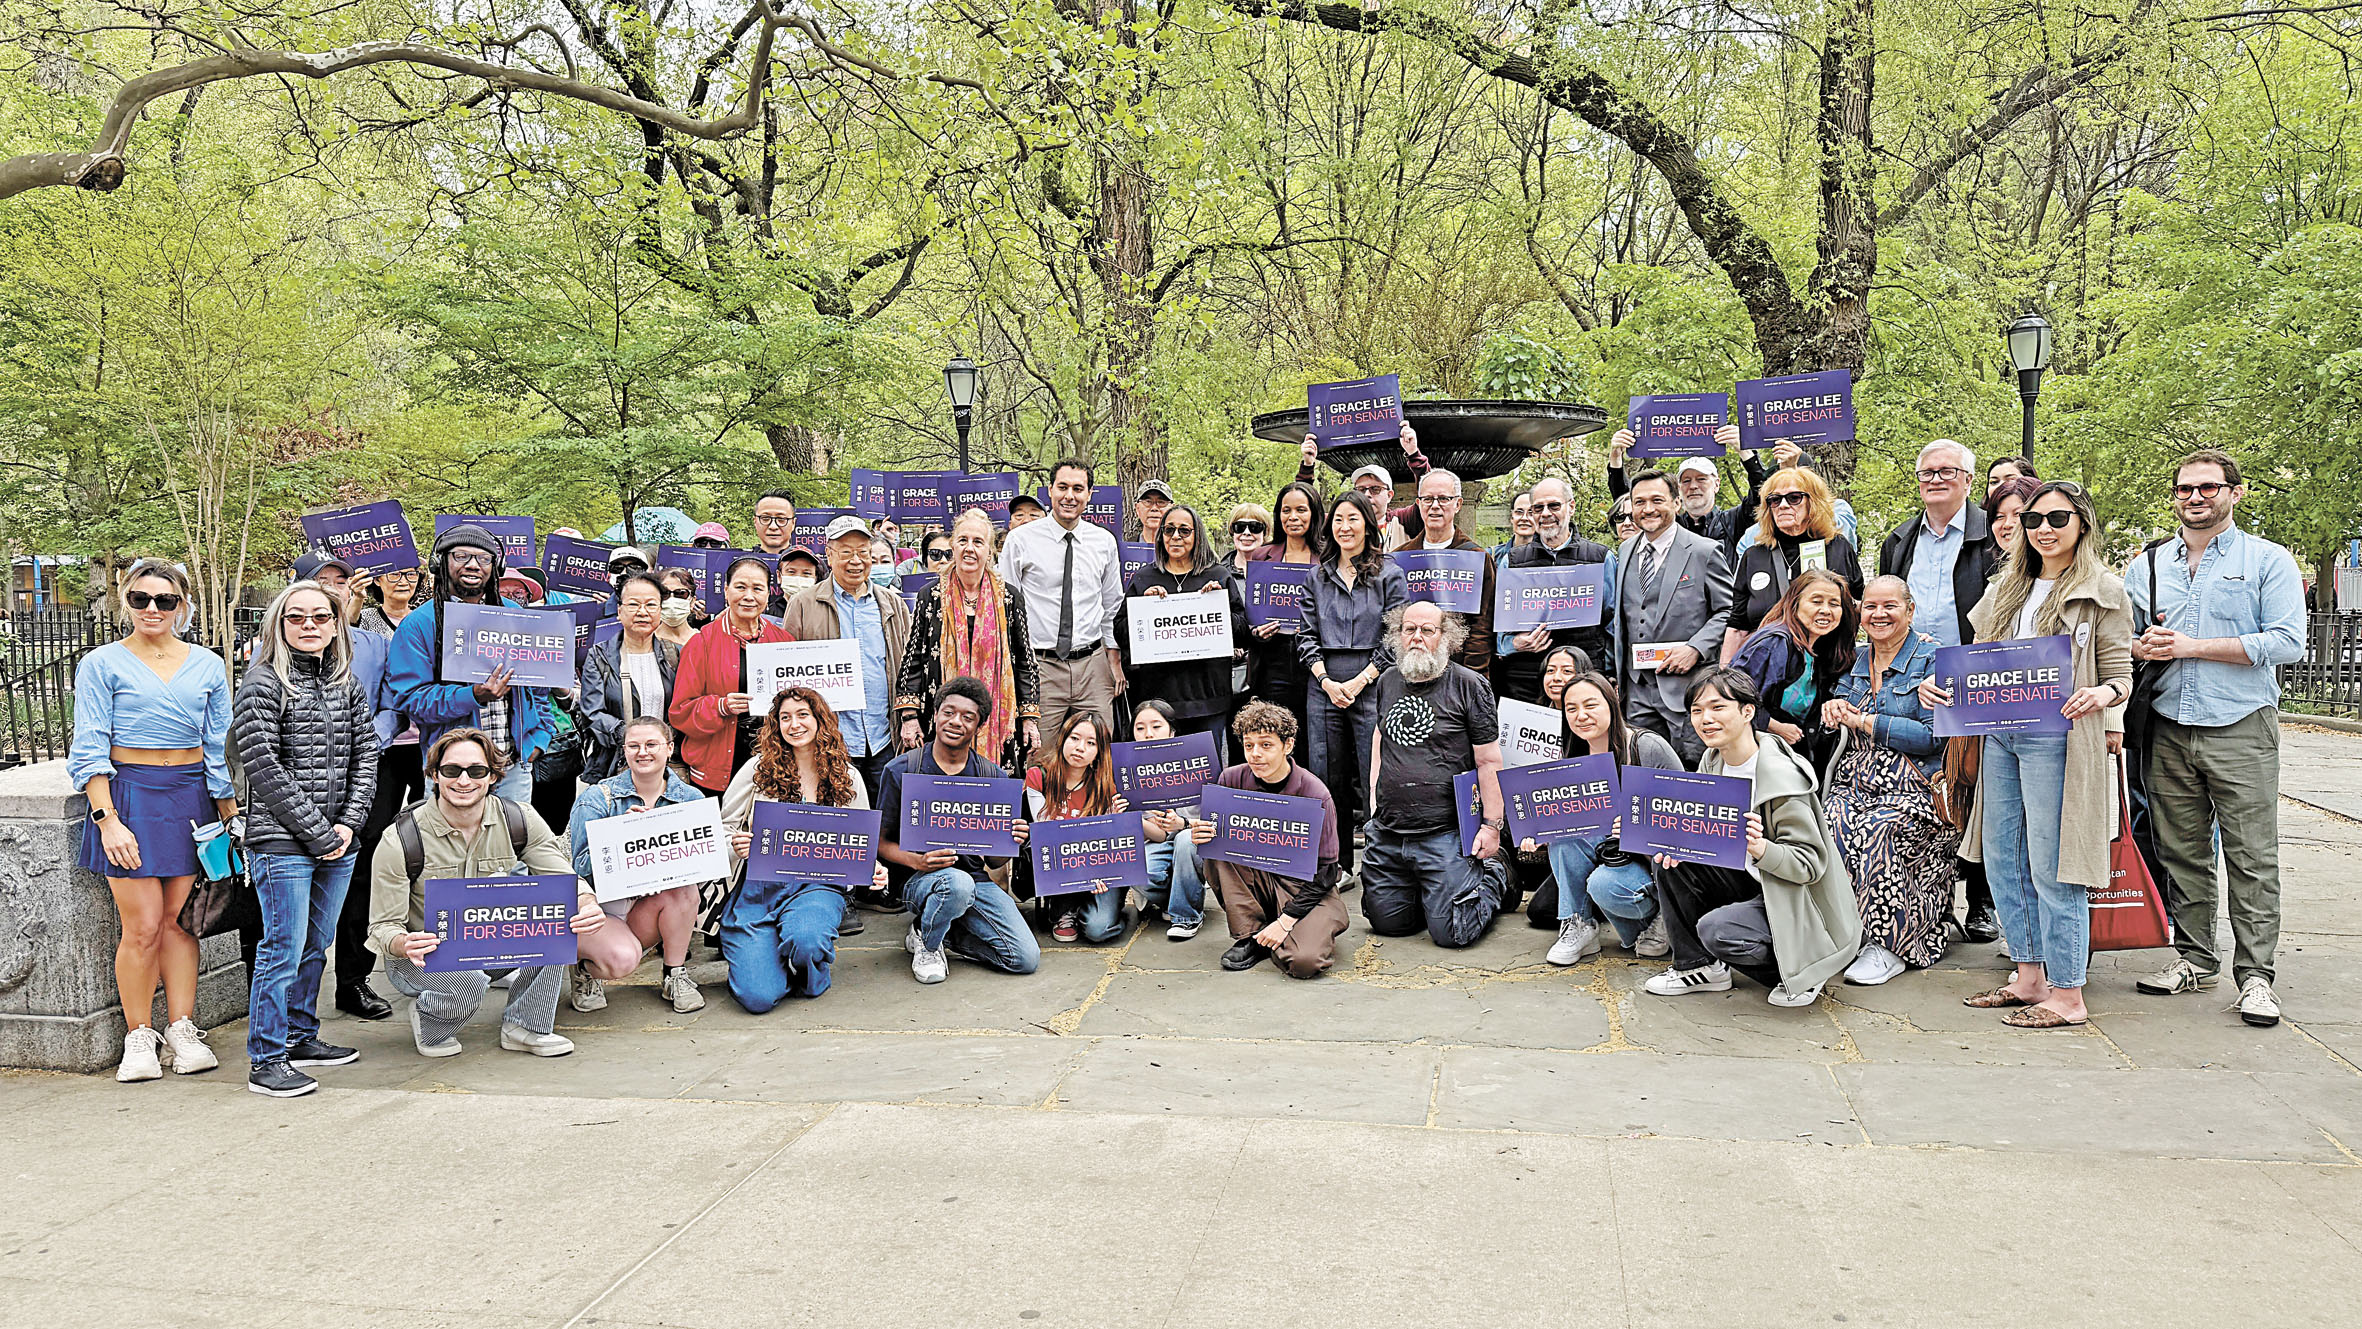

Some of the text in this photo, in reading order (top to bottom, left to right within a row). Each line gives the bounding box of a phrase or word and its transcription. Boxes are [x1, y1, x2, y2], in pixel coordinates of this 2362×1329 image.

[1330, 396, 1395, 414] GRACE LEE
[1764, 394, 1841, 412] GRACE LEE
[1330, 408, 1397, 426] FOR SENATE
[1651, 414, 1718, 426] GRACE LEE
[1765, 407, 1842, 426] FOR SENATE
[1650, 425, 1718, 437] FOR SENATE
[903, 488, 937, 497] GRACE
[960, 490, 1013, 502] GRACE LEE
[981, 501, 1009, 511] SENAT
[1096, 505, 1115, 513] LEE
[329, 528, 371, 546] GRACE
[373, 523, 400, 538] LEE
[795, 526, 828, 535] GRAC
[354, 536, 404, 556] SENATE
[506, 536, 527, 545] LEE
[795, 536, 815, 545] FOR
[567, 556, 607, 571] GRACE
[565, 566, 610, 582] FOR SEN
[1407, 570, 1475, 581] GRACE LEE
[1270, 584, 1302, 595] GRAC
[1407, 581, 1474, 592] FOR SENATE
[1522, 585, 1594, 598] GRACE LEE
[1270, 596, 1291, 606] FOR
[1522, 597, 1594, 610] FOR SENATE
[1154, 613, 1222, 628] GRACE LEE
[477, 631, 532, 647] GRACE
[536, 637, 564, 648] LEE
[1155, 625, 1224, 640] FOR SENATE
[476, 645, 564, 663] FOR SENATE
[776, 663, 852, 678] GRACE LEE
[1967, 668, 2059, 688] GRACE LEE
[806, 676, 854, 689] SENATE
[1968, 685, 2060, 705] FOR SENATE
[1520, 727, 1563, 746] GRACE
[1517, 740, 1540, 755] FOR
[1137, 756, 1209, 776] GRACE LEE
[1139, 769, 1212, 789] FOR SENATE
[1532, 780, 1609, 803] GRACE LEE
[930, 801, 1011, 816] GRACE LEE
[1535, 796, 1613, 818] FOR SENATE
[1652, 798, 1738, 822] GRACE LEE
[930, 816, 1011, 831] FOR SENATE
[1229, 815, 1279, 831] GRACE
[1283, 821, 1310, 835] LEE
[1652, 814, 1738, 838] FOR SENATE
[624, 825, 713, 854] GRACE LEE
[783, 830, 868, 847] GRACE LEE
[1061, 836, 1135, 856] GRACE LEE
[1229, 828, 1309, 849] FOR SENATE
[626, 840, 716, 869] FOR SENATE
[782, 845, 866, 860] FOR SENATE
[1062, 850, 1136, 870] FOR SENATE
[2111, 870, 2126, 878] tan
[2086, 889, 2144, 900] portunities
[464, 905, 565, 922] GRACE LEE
[464, 921, 566, 940] FOR SENATE
